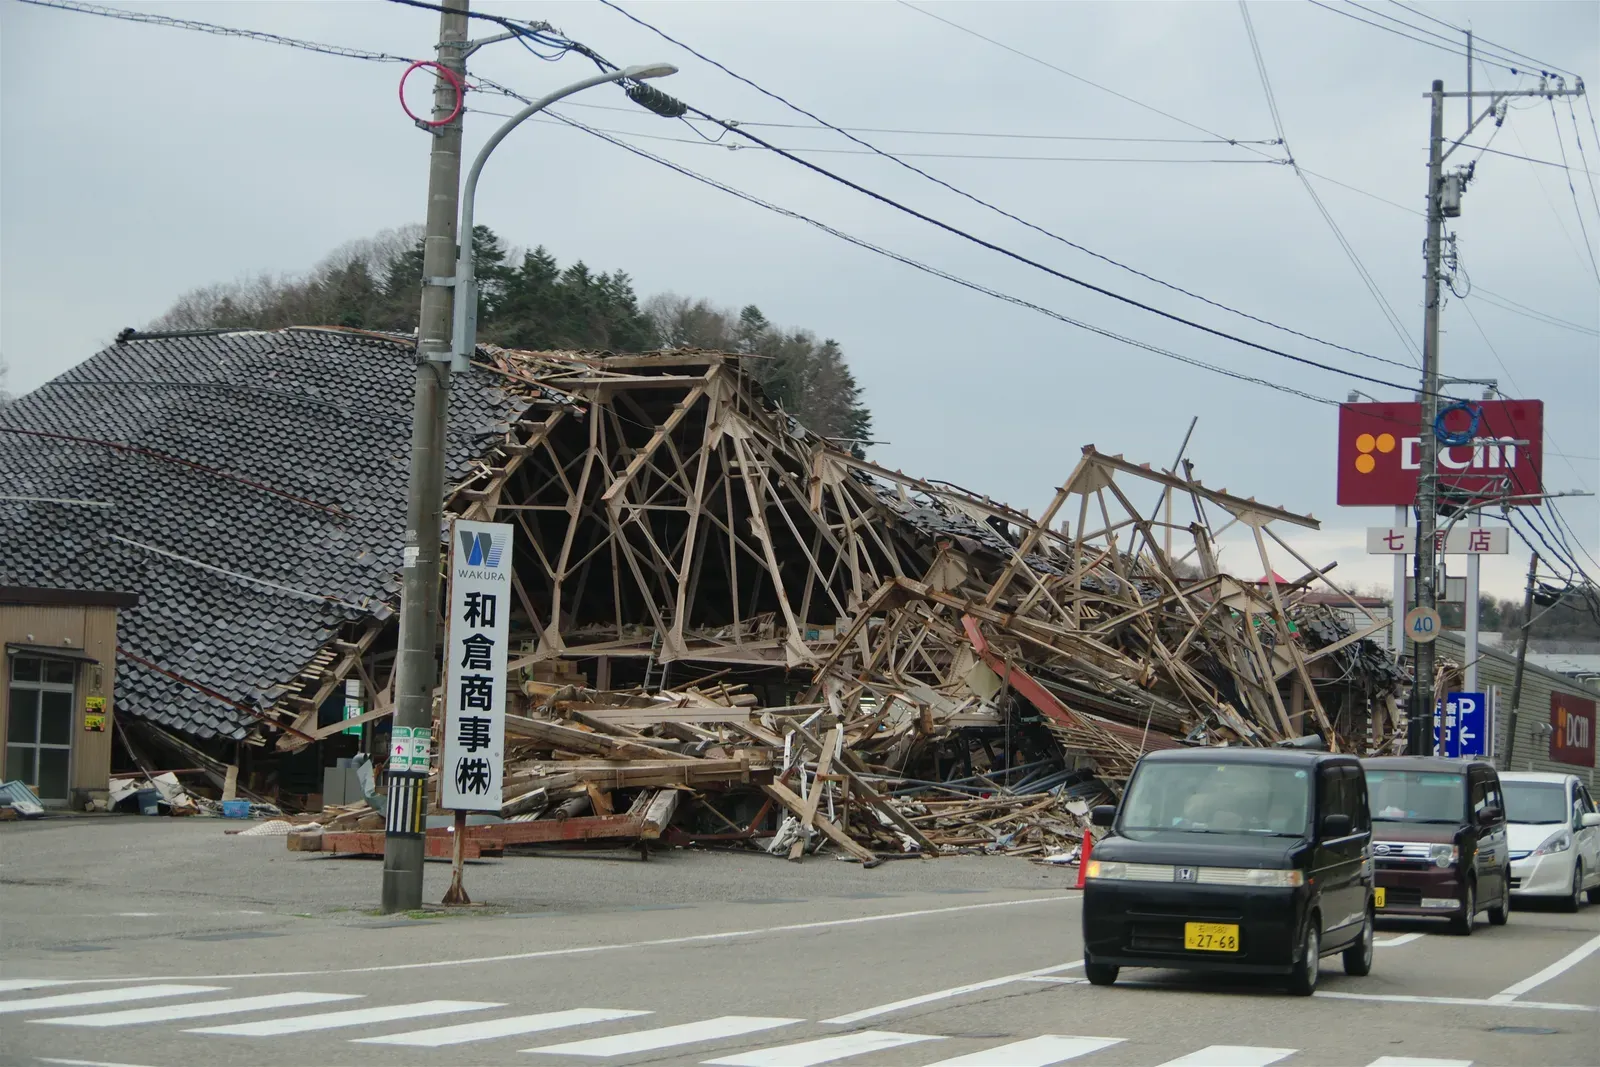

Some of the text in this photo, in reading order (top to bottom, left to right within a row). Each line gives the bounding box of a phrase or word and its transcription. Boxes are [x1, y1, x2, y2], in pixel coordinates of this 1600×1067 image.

[458, 569, 506, 581] WAKURA
[1413, 616, 1433, 632] 40
[1458, 698, 1476, 721] P
